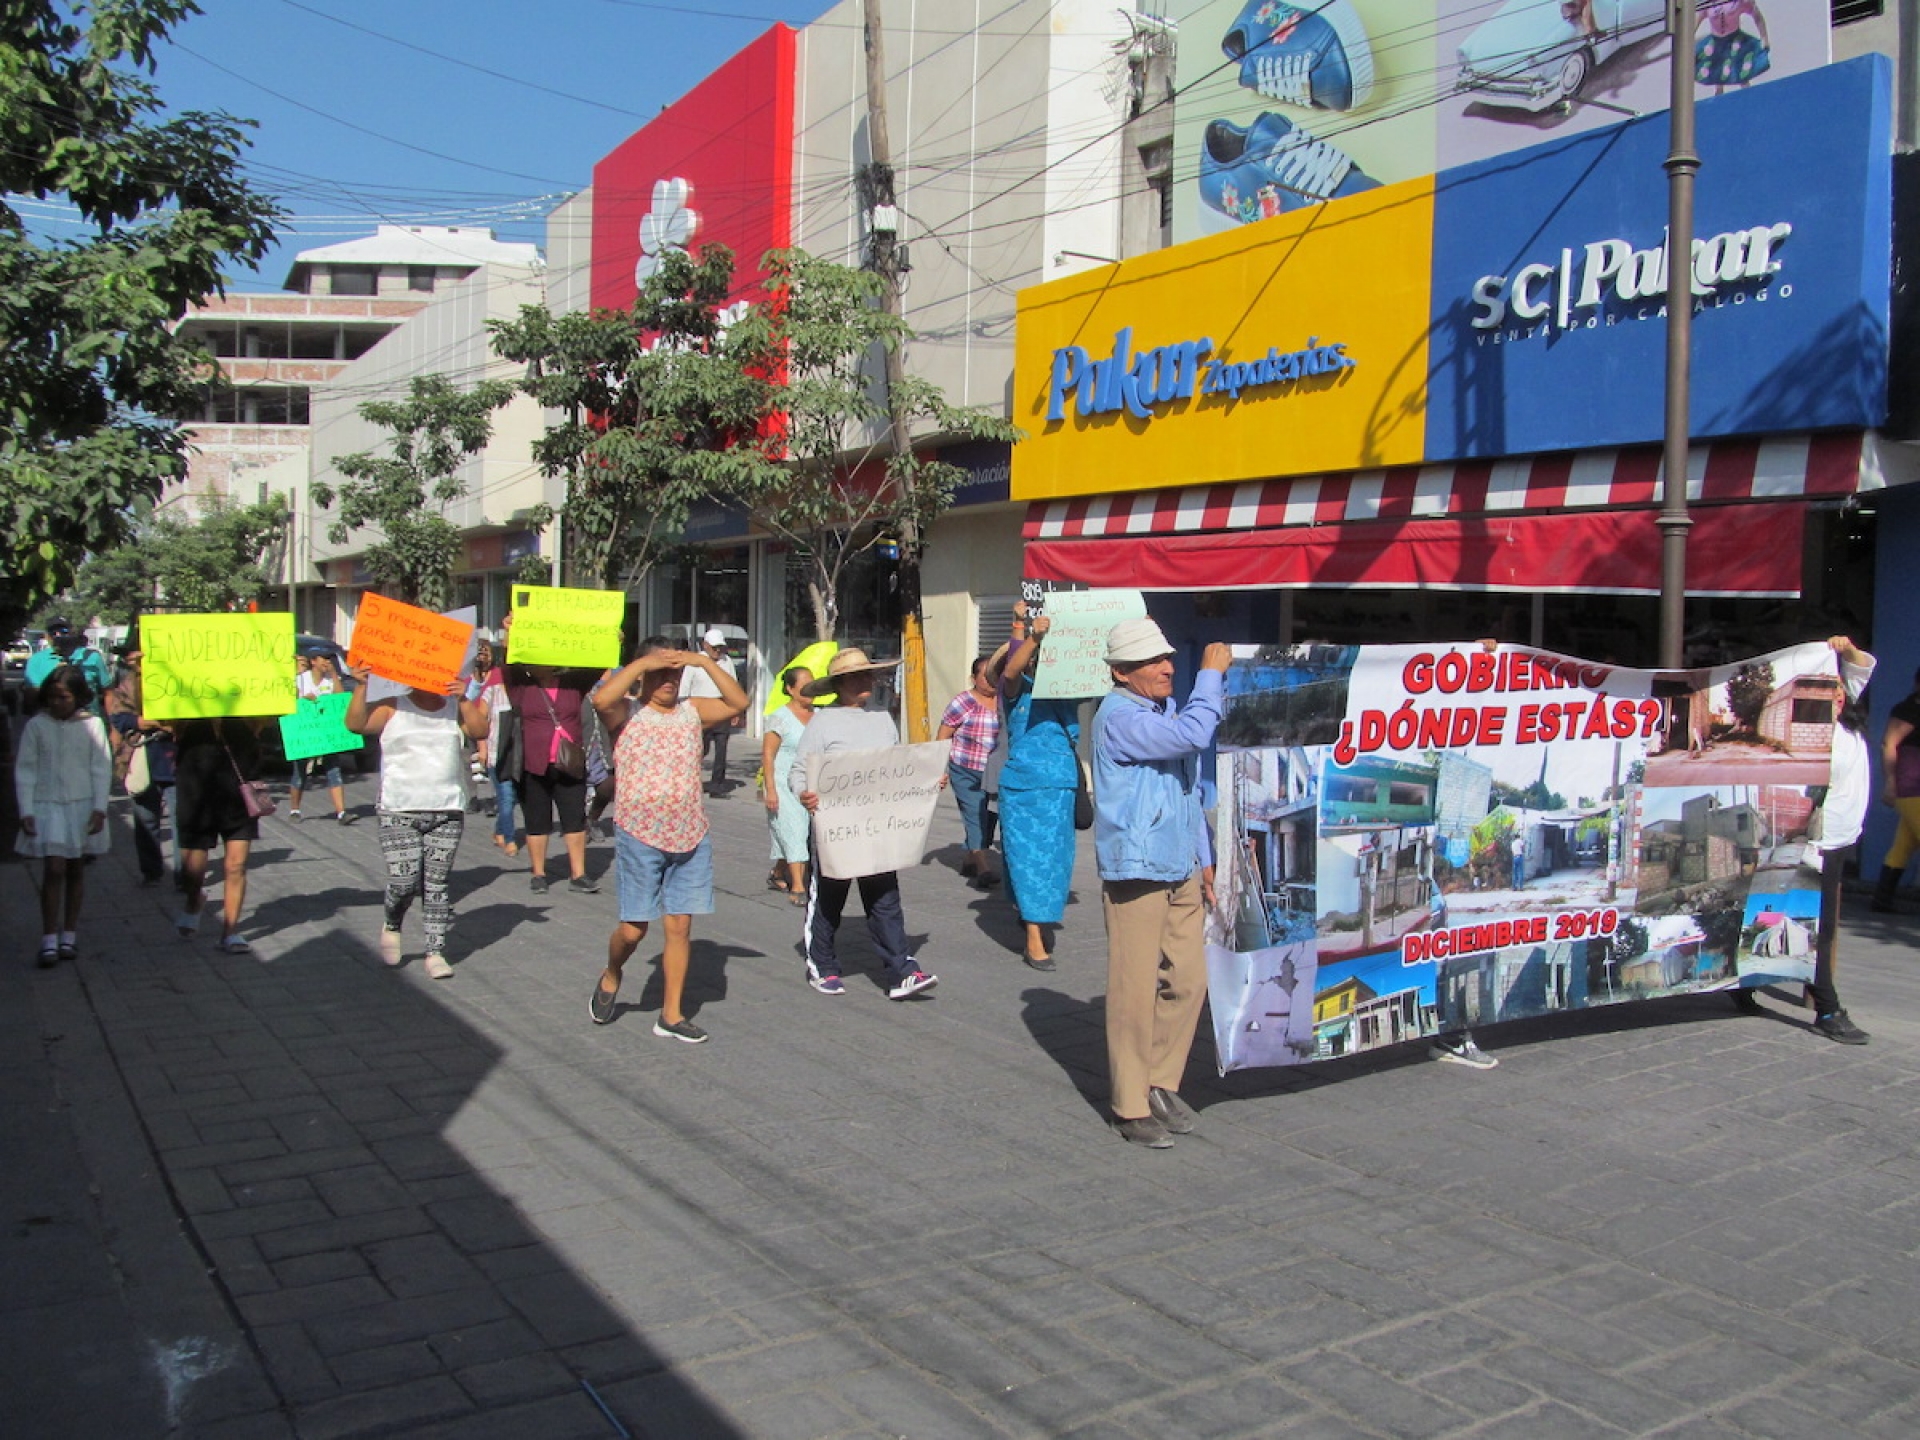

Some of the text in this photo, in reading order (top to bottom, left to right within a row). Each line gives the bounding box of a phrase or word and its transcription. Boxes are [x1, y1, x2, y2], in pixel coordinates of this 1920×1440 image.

[1476, 284, 1793, 347] VENTA POR CAALOGO
[365, 597, 380, 618] 5
[514, 637, 598, 653] DE PAPEL
[1402, 651, 1612, 694] GOBIERNO
[1333, 692, 1662, 765] ¿DÓNDE ESTÁS?
[817, 760, 915, 794] GOBIERNO
[865, 816, 881, 838] EL
[1404, 909, 1617, 964] DICIEMBRE 2019
